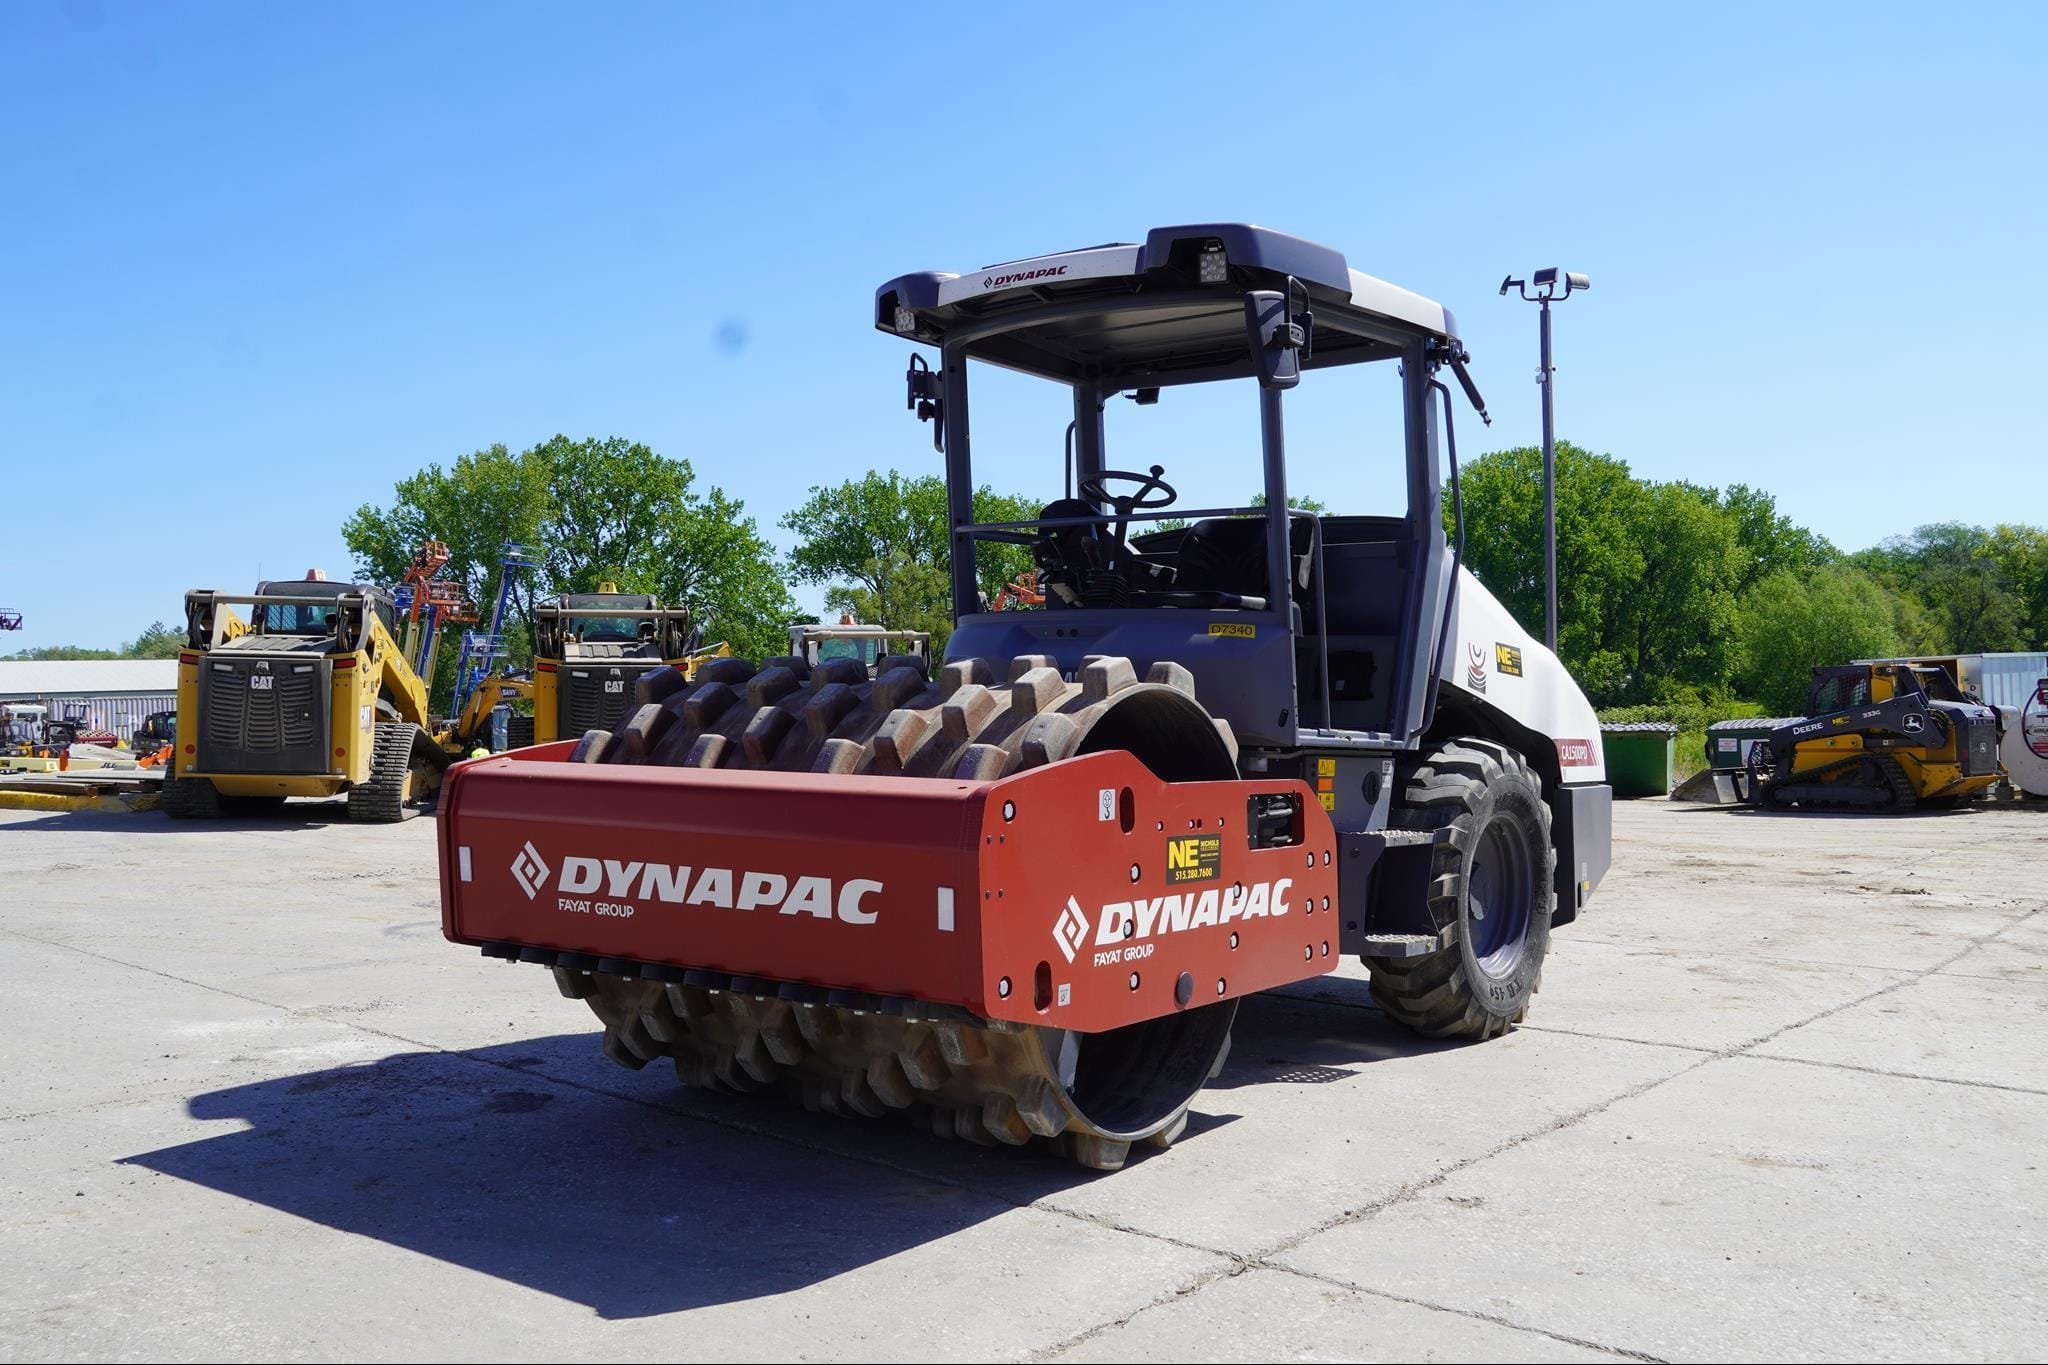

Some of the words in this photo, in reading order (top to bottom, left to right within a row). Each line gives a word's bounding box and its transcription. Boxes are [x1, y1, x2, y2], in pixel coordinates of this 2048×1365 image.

[994, 266, 1067, 285] DYNAPAC
[1211, 625, 1252, 635] D7340
[1497, 645, 1512, 665] NE
[251, 676, 273, 690] CAT
[605, 681, 624, 692] CAT
[1793, 722, 1823, 735] DEERE
[1169, 839, 1199, 869] NE
[1175, 867, 1213, 881] 515.280.7600
[558, 855, 883, 925] DYNAPAC
[558, 898, 591, 913] FAYAT
[594, 902, 634, 918] GROUP
[1094, 878, 1293, 946] DYNAPAC
[1094, 949, 1122, 968] FAYAT
[1124, 943, 1154, 962] GROUP
